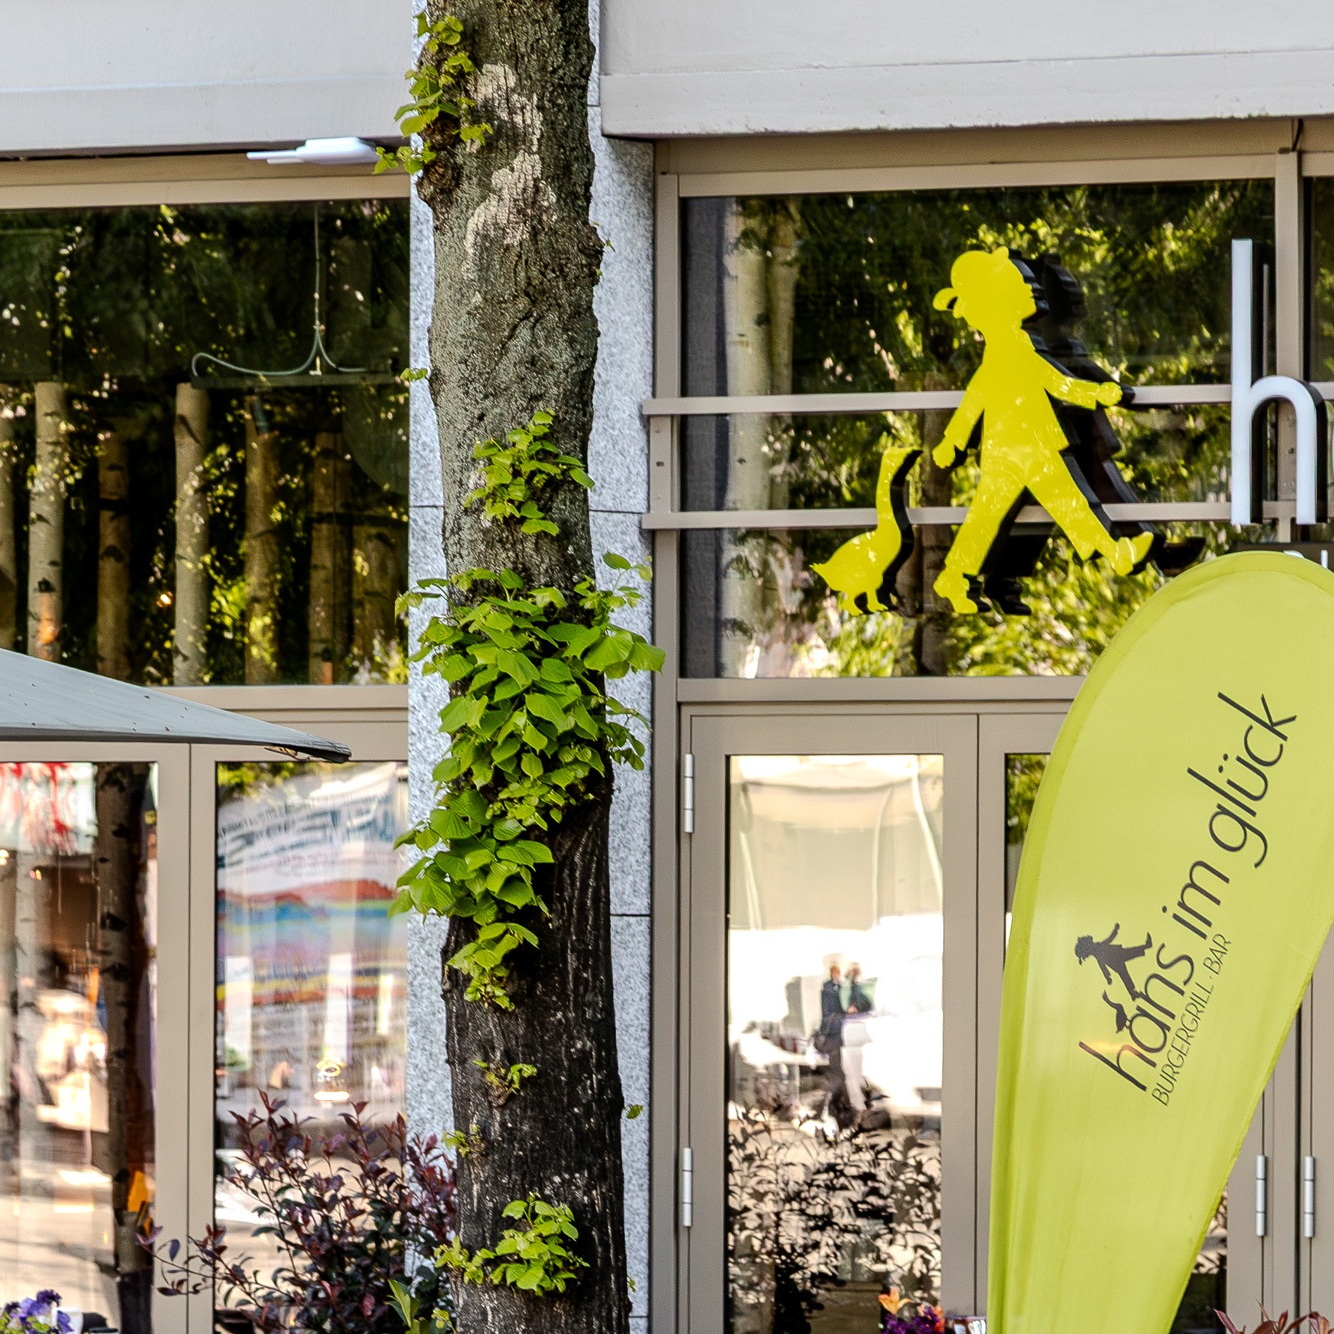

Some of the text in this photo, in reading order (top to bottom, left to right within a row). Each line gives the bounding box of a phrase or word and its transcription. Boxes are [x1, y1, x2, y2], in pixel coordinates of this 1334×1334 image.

[1079, 690, 1298, 1092] hans im glück
[1151, 933, 1232, 1107] BURGERGRILL BAR
